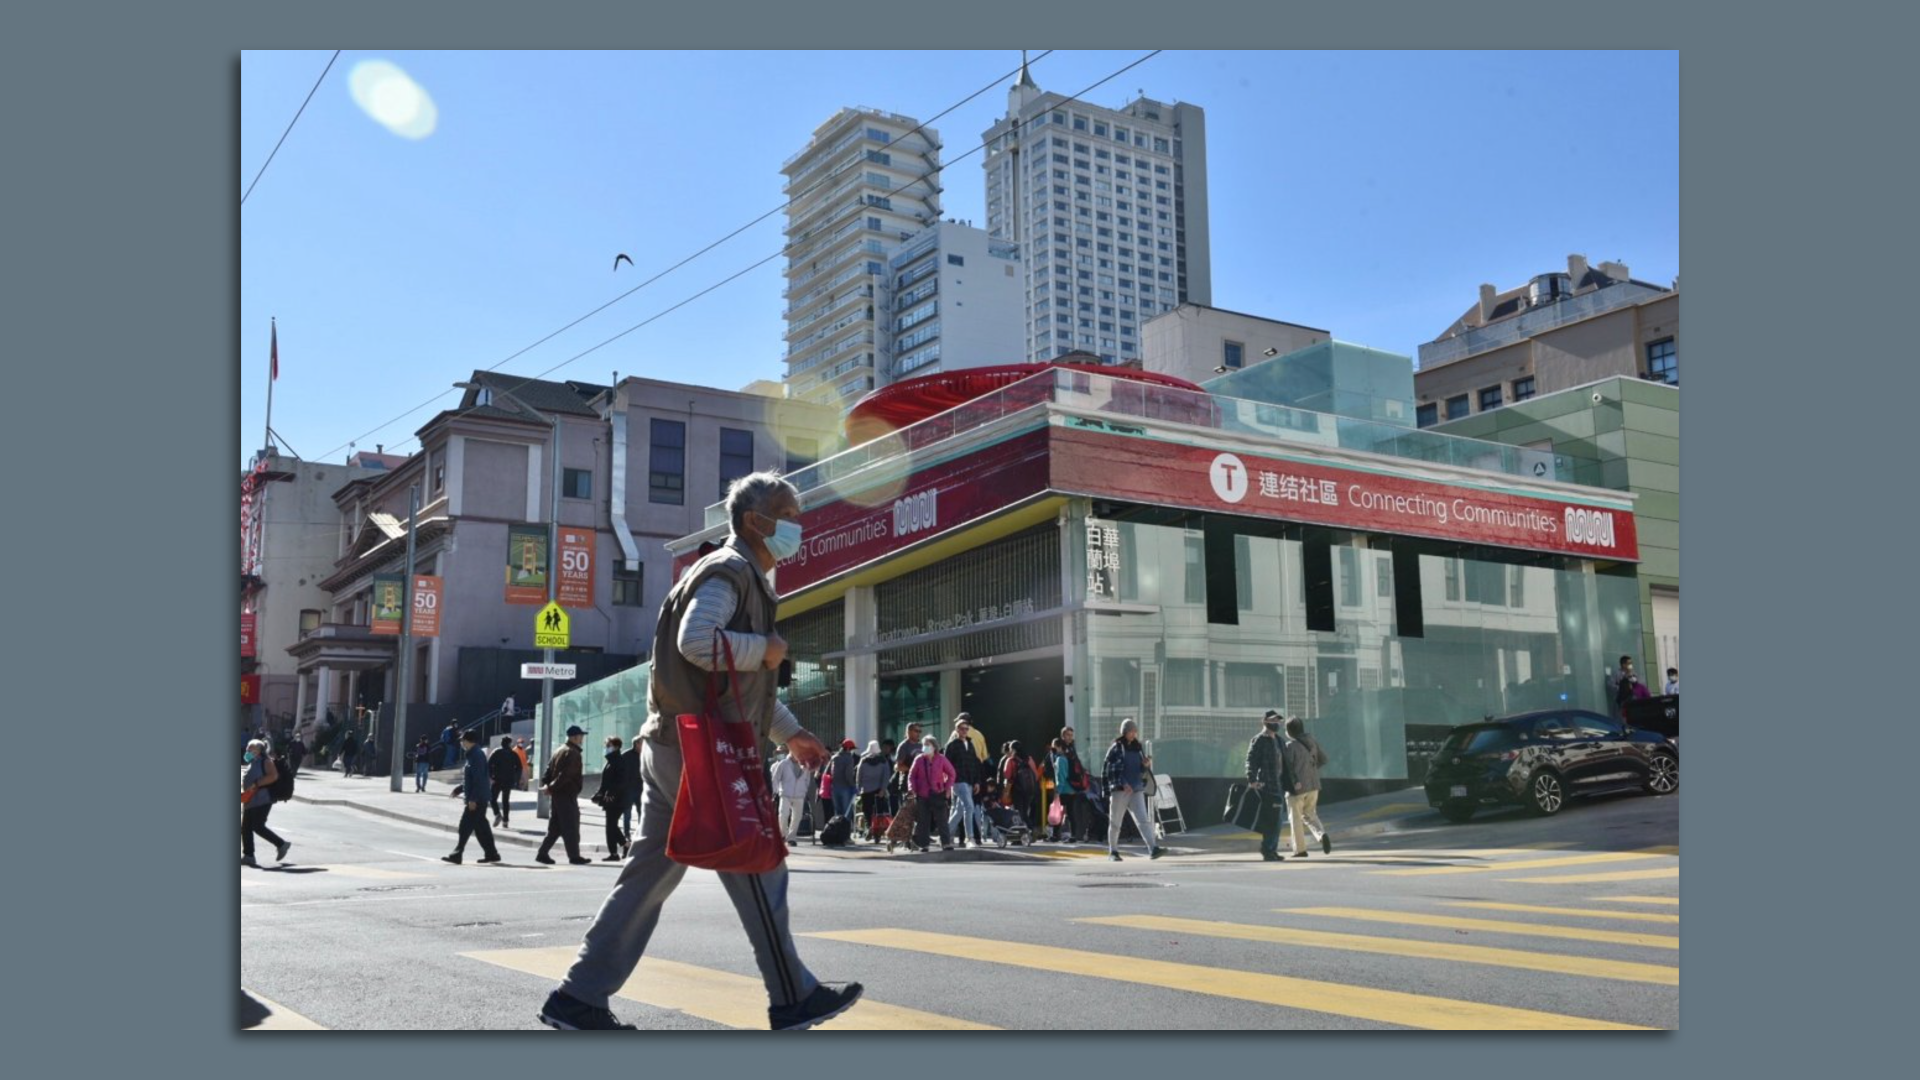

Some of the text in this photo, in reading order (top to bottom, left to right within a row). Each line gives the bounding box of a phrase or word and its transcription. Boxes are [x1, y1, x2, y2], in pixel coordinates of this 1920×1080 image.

[1220, 464, 1238, 491] T
[1348, 485, 1557, 532] Connecting Communities
[810, 518, 887, 557] Communities
[562, 550, 590, 572] 50
[562, 570, 589, 580] YEARS
[414, 592, 437, 609] 50
[414, 607, 436, 615] YEARS
[928, 618, 951, 635] Rose
[955, 609, 974, 629] Pak
[537, 635, 567, 646] SCHOOL
[545, 666, 575, 676] Metro
